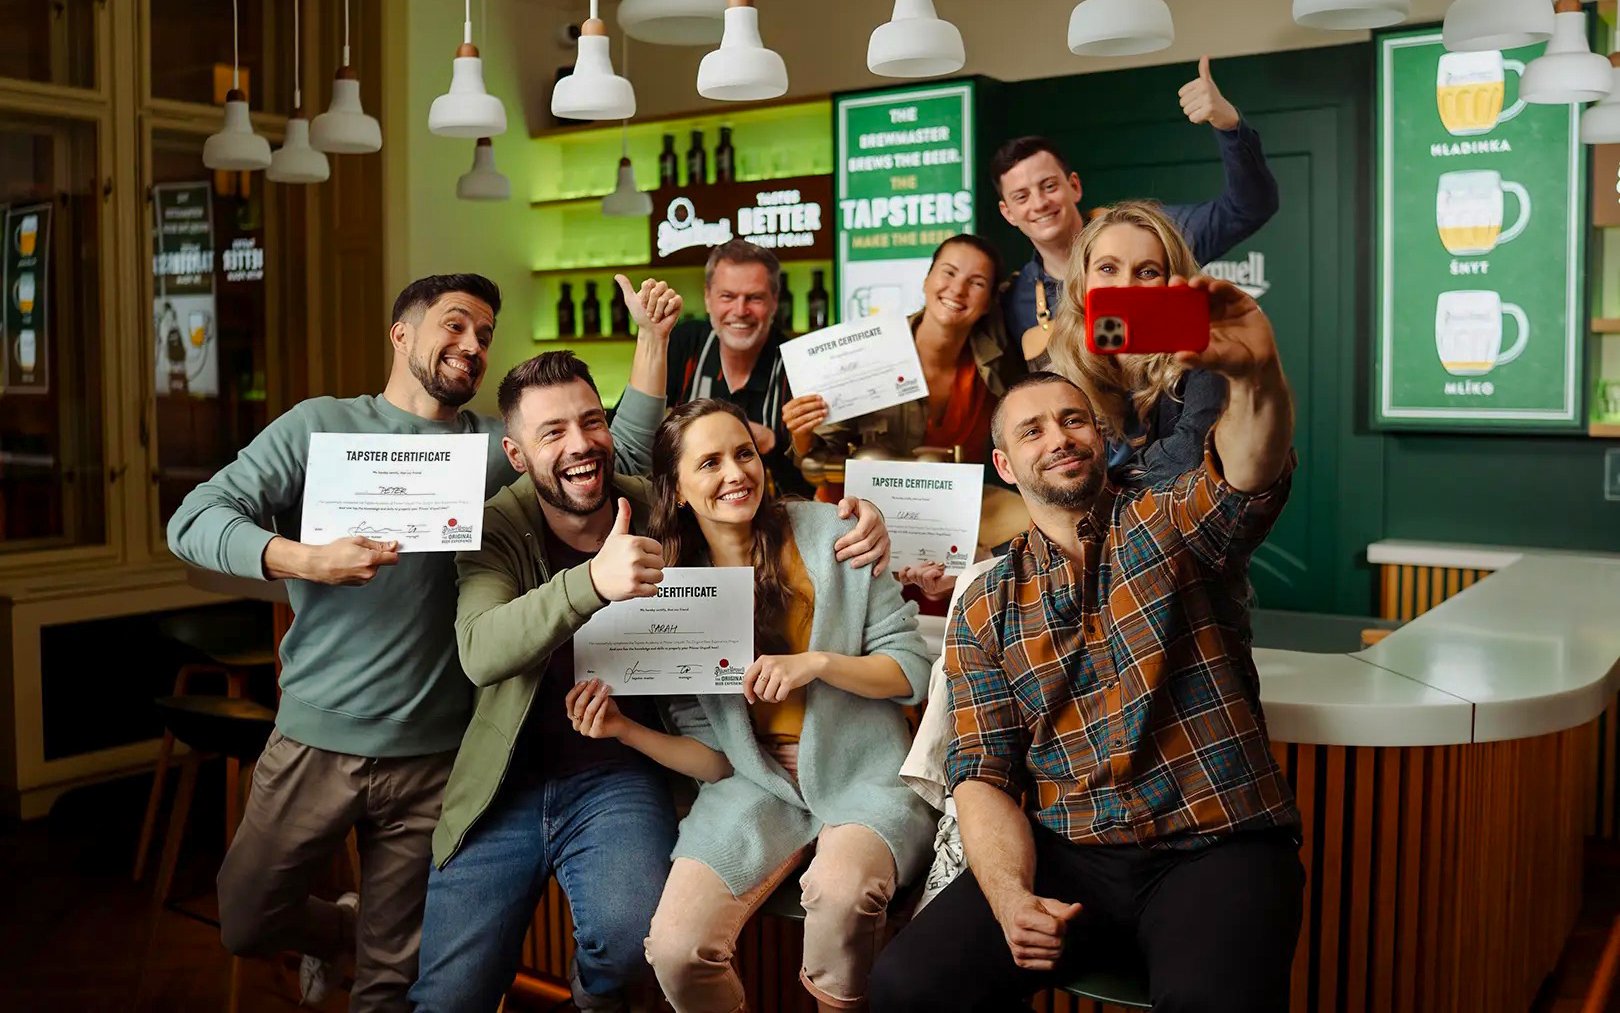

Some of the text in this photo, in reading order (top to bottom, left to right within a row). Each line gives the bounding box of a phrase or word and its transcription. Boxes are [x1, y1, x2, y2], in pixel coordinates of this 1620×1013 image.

[889, 106, 918, 124] THE
[859, 126, 950, 149] BREWMASTER
[848, 154, 893, 173] BREWS
[893, 151, 921, 168] THE
[890, 174, 917, 190] THE
[738, 202, 821, 235] BETTER
[839, 191, 972, 230] TAPSTERS
[851, 234, 889, 248] MAKE
[892, 231, 917, 246] THE
[807, 341, 837, 356] TAPSTER
[838, 327, 882, 346] CERTIFICATE
[346, 450, 451, 462] TAPSTER CERTIFICATE
[872, 477, 953, 490] TAPSTER CERTIFICATE
[656, 586, 718, 598] CERTIFICATE
[649, 624, 678, 634] SARAH
